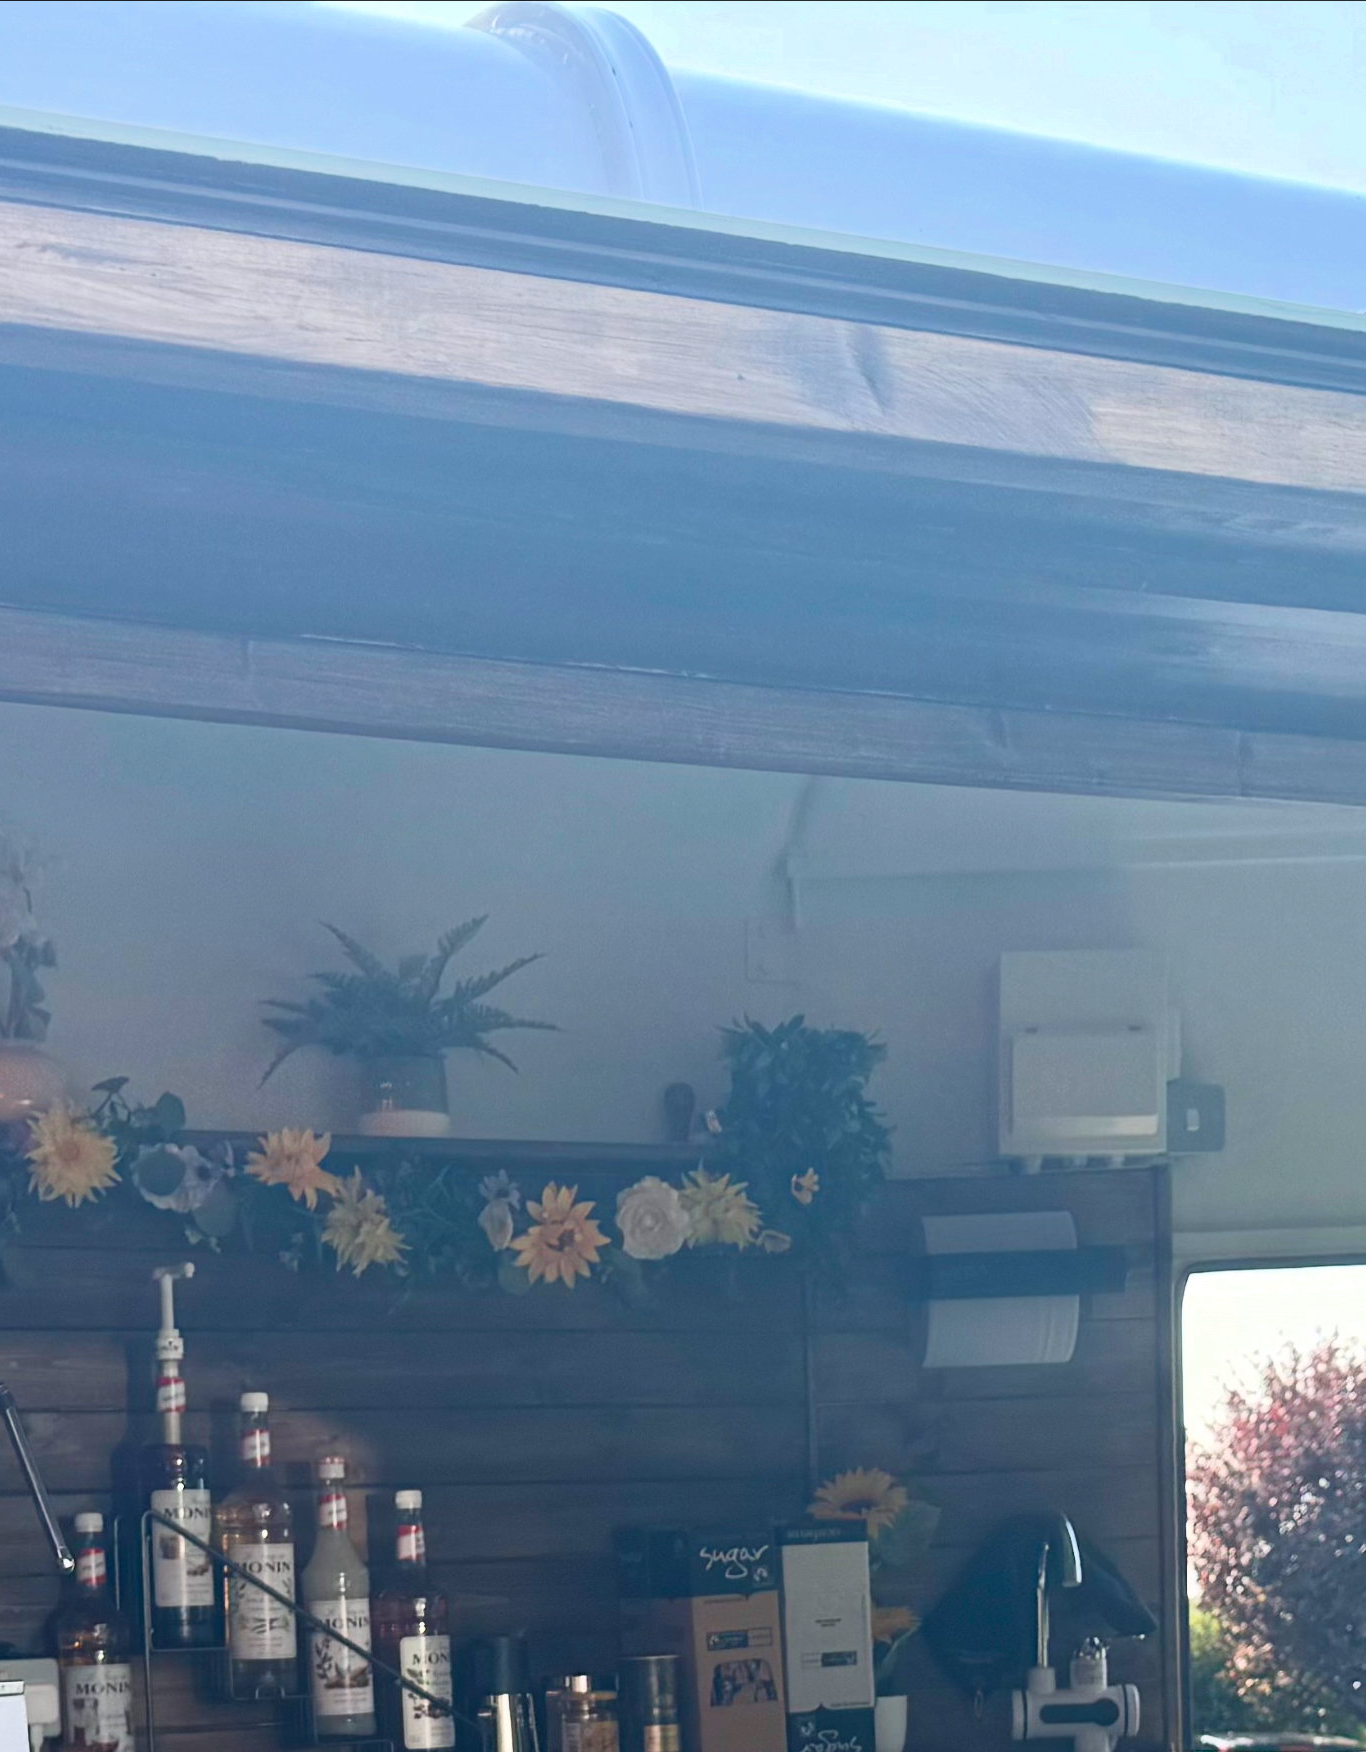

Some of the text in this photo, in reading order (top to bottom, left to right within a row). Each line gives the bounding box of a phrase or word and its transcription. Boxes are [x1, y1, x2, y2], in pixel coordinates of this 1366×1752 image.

[164, 1506, 211, 1520] MONI
[699, 1544, 769, 1579] sugar
[75, 1682, 132, 1696] MONIN
